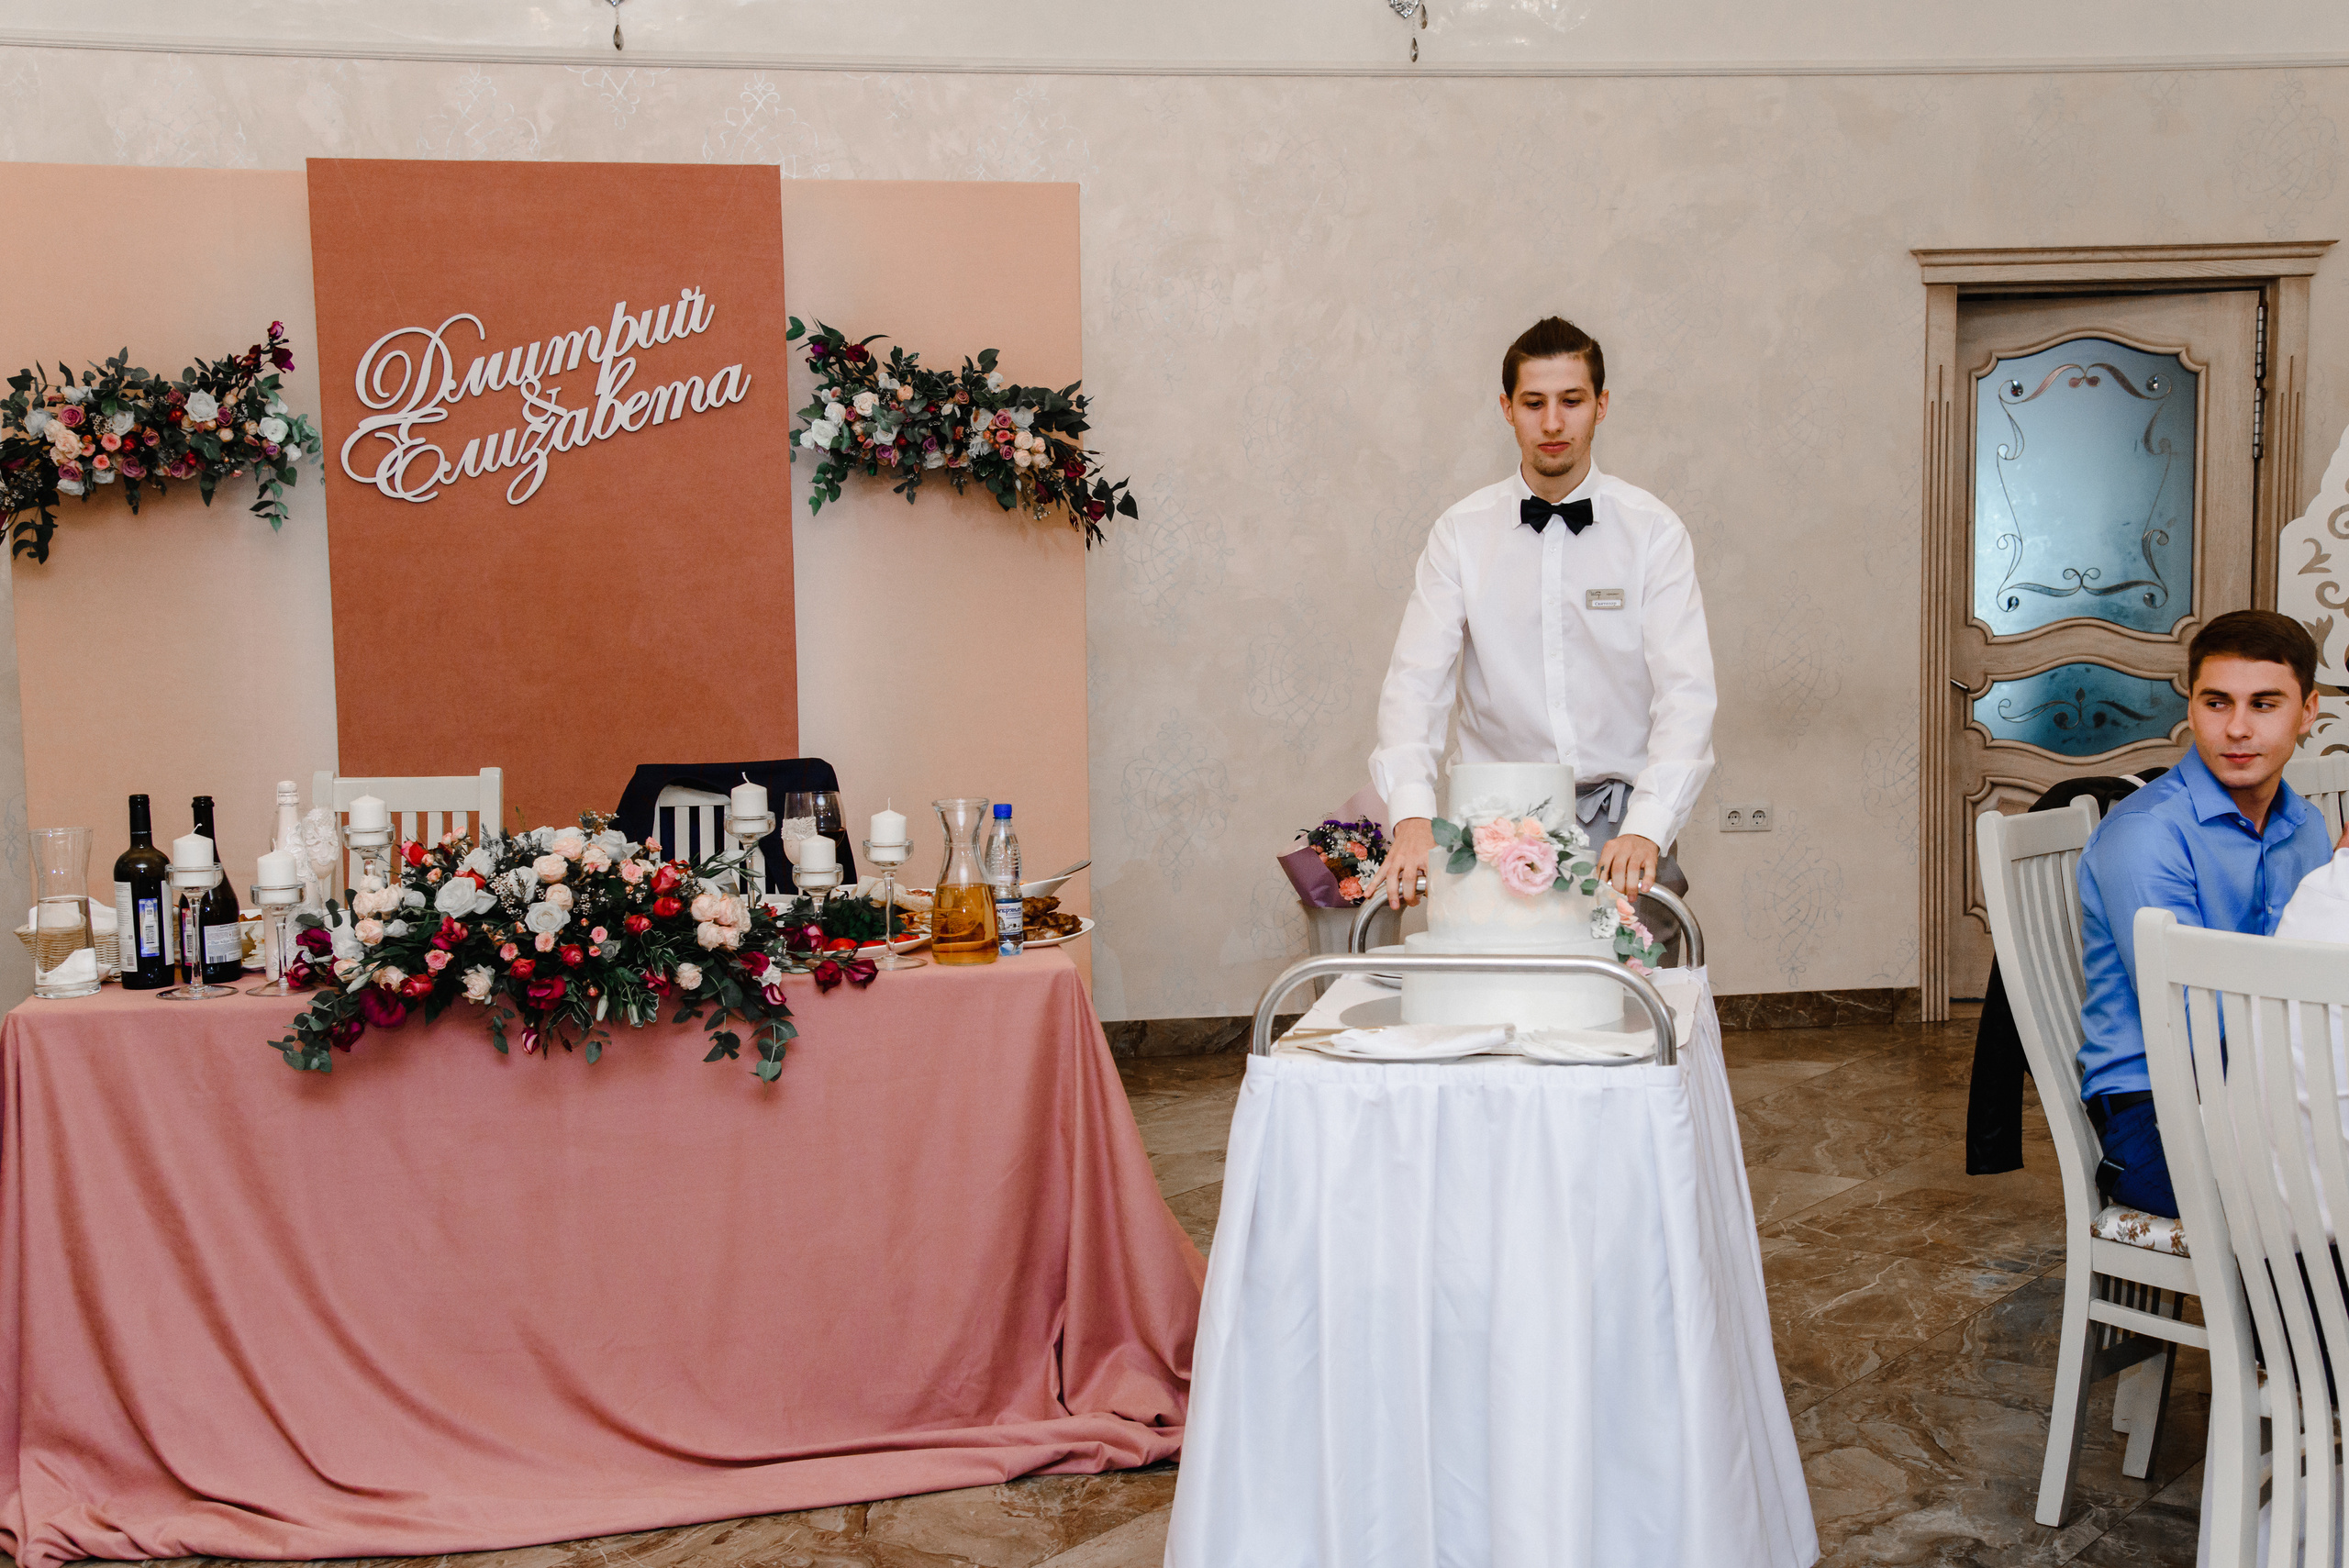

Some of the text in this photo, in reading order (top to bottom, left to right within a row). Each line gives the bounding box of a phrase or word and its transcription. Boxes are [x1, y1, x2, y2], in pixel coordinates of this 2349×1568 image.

[355, 285, 715, 409] Дмитрий
[520, 377, 569, 425] &
[340, 356, 751, 506] Елизавета
